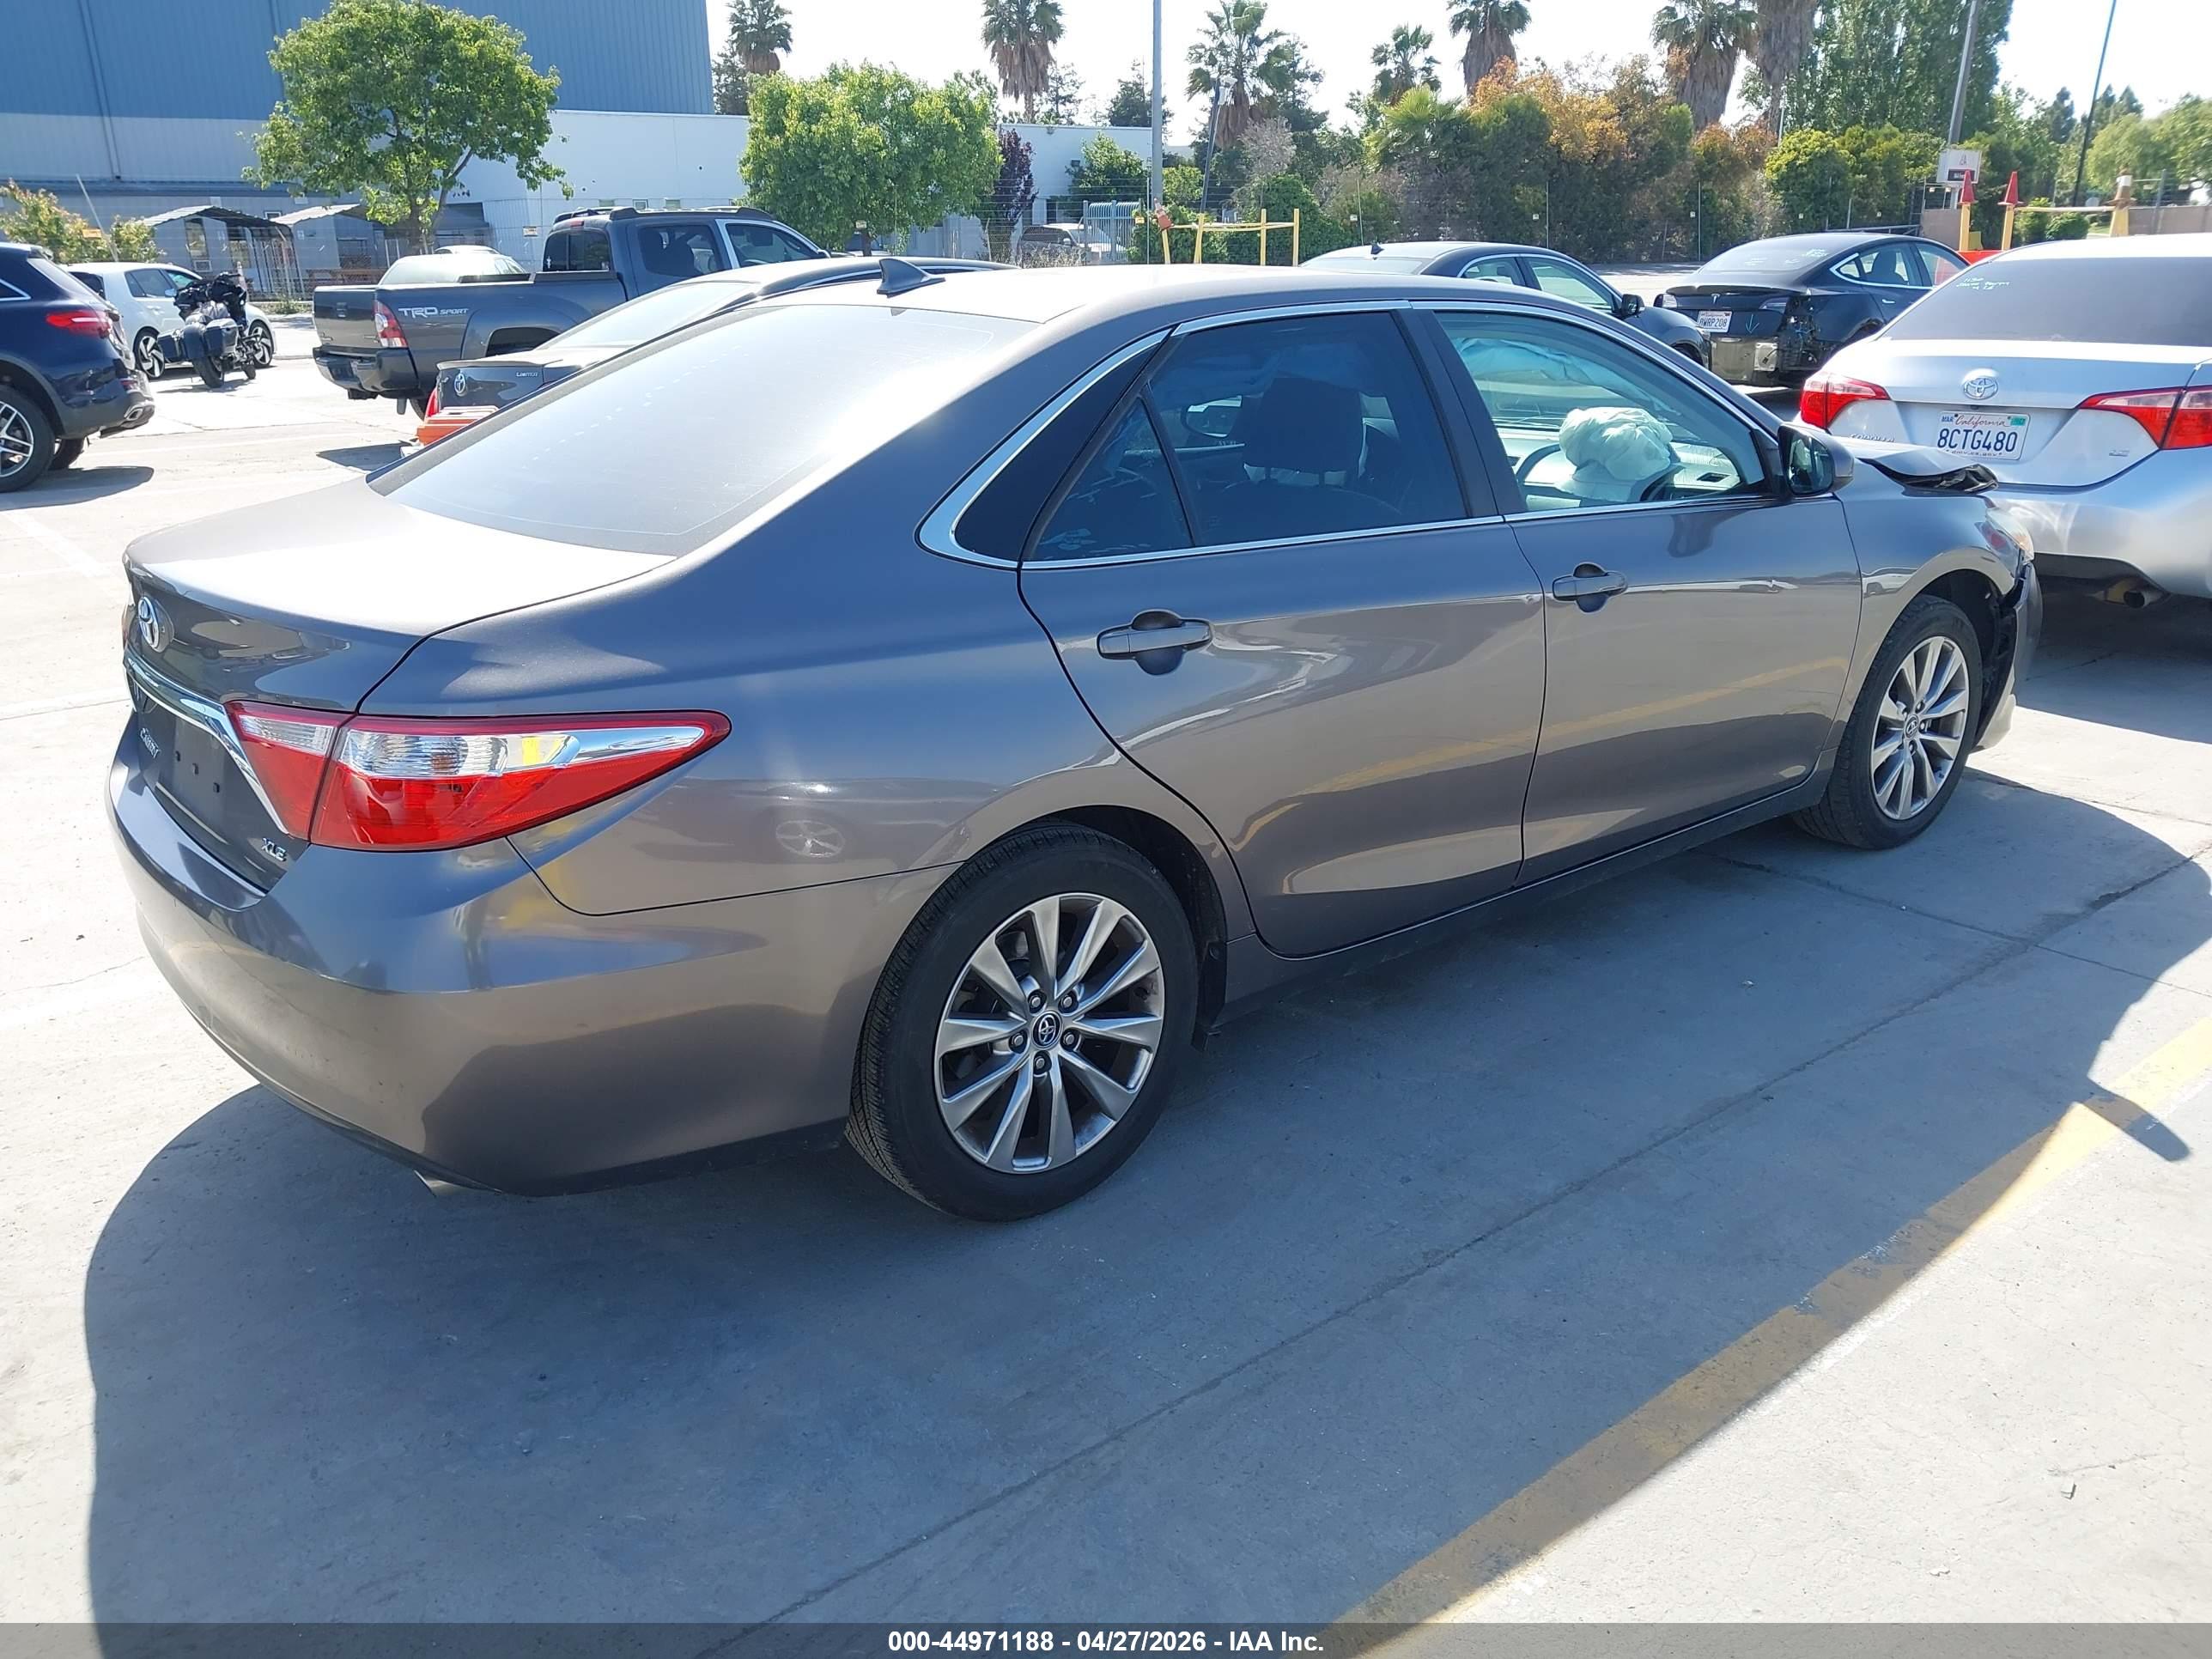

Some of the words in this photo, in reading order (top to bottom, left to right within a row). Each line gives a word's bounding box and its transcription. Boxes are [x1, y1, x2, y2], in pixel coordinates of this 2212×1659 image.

[398, 307, 438, 319] TRD
[1955, 415, 2010, 428] California
[1937, 428, 2018, 453] 8CTG480
[261, 837, 286, 861] XLE
